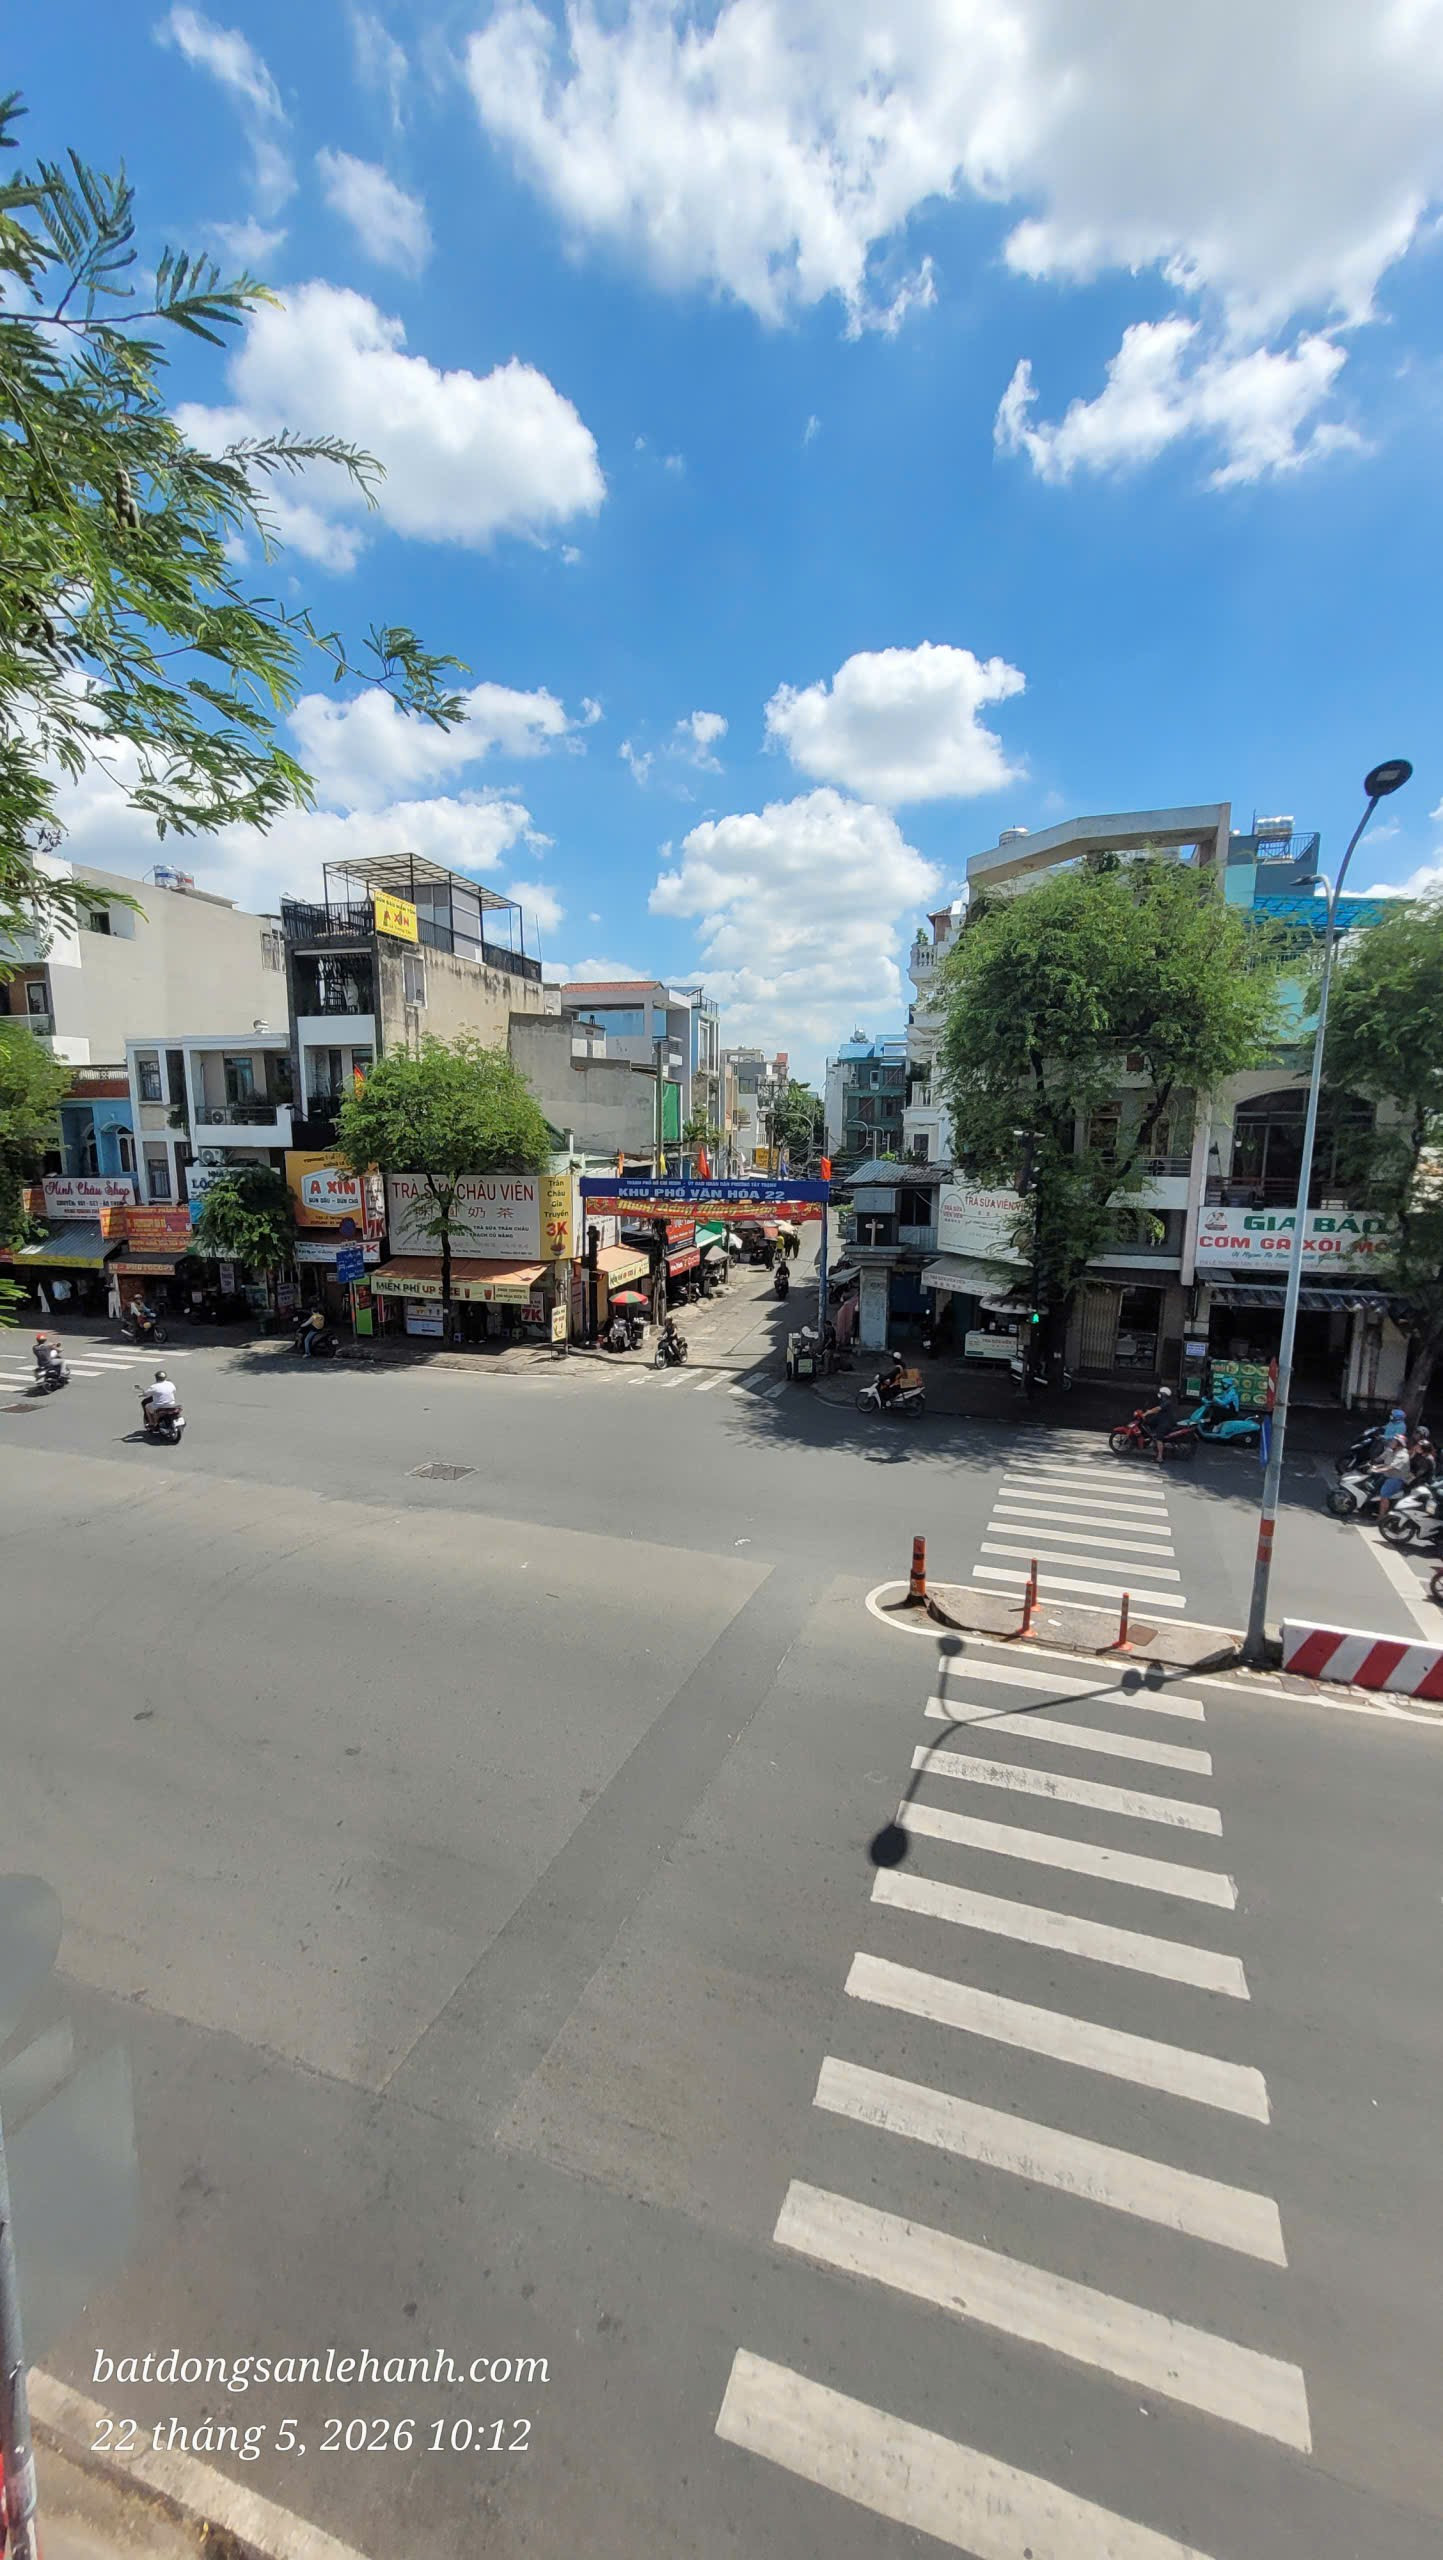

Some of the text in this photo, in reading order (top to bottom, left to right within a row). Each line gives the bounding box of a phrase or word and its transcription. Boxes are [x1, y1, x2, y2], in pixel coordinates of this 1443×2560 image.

[311, 1181, 356, 1194] A XIN
[391, 1178, 418, 1198] TRÀ
[424, 1179, 451, 1199] SA
[456, 1180, 496, 1200] CHÂU
[500, 1180, 534, 1201] VIÊN
[618, 1186, 785, 1200] KHU PHỐ VĂN HÓA 22
[544, 1210, 569, 1219] Truyền
[546, 1221, 568, 1236] 3K
[1244, 1213, 1387, 1234] GIA BẢO
[1199, 1235, 1251, 1250] CƠM
[1260, 1234, 1292, 1251] GÀ
[1303, 1237, 1342, 1252] XÔI
[376, 1279, 460, 1296] MIỄN PHÍ UP SE
[522, 1308, 543, 1322] 7K
